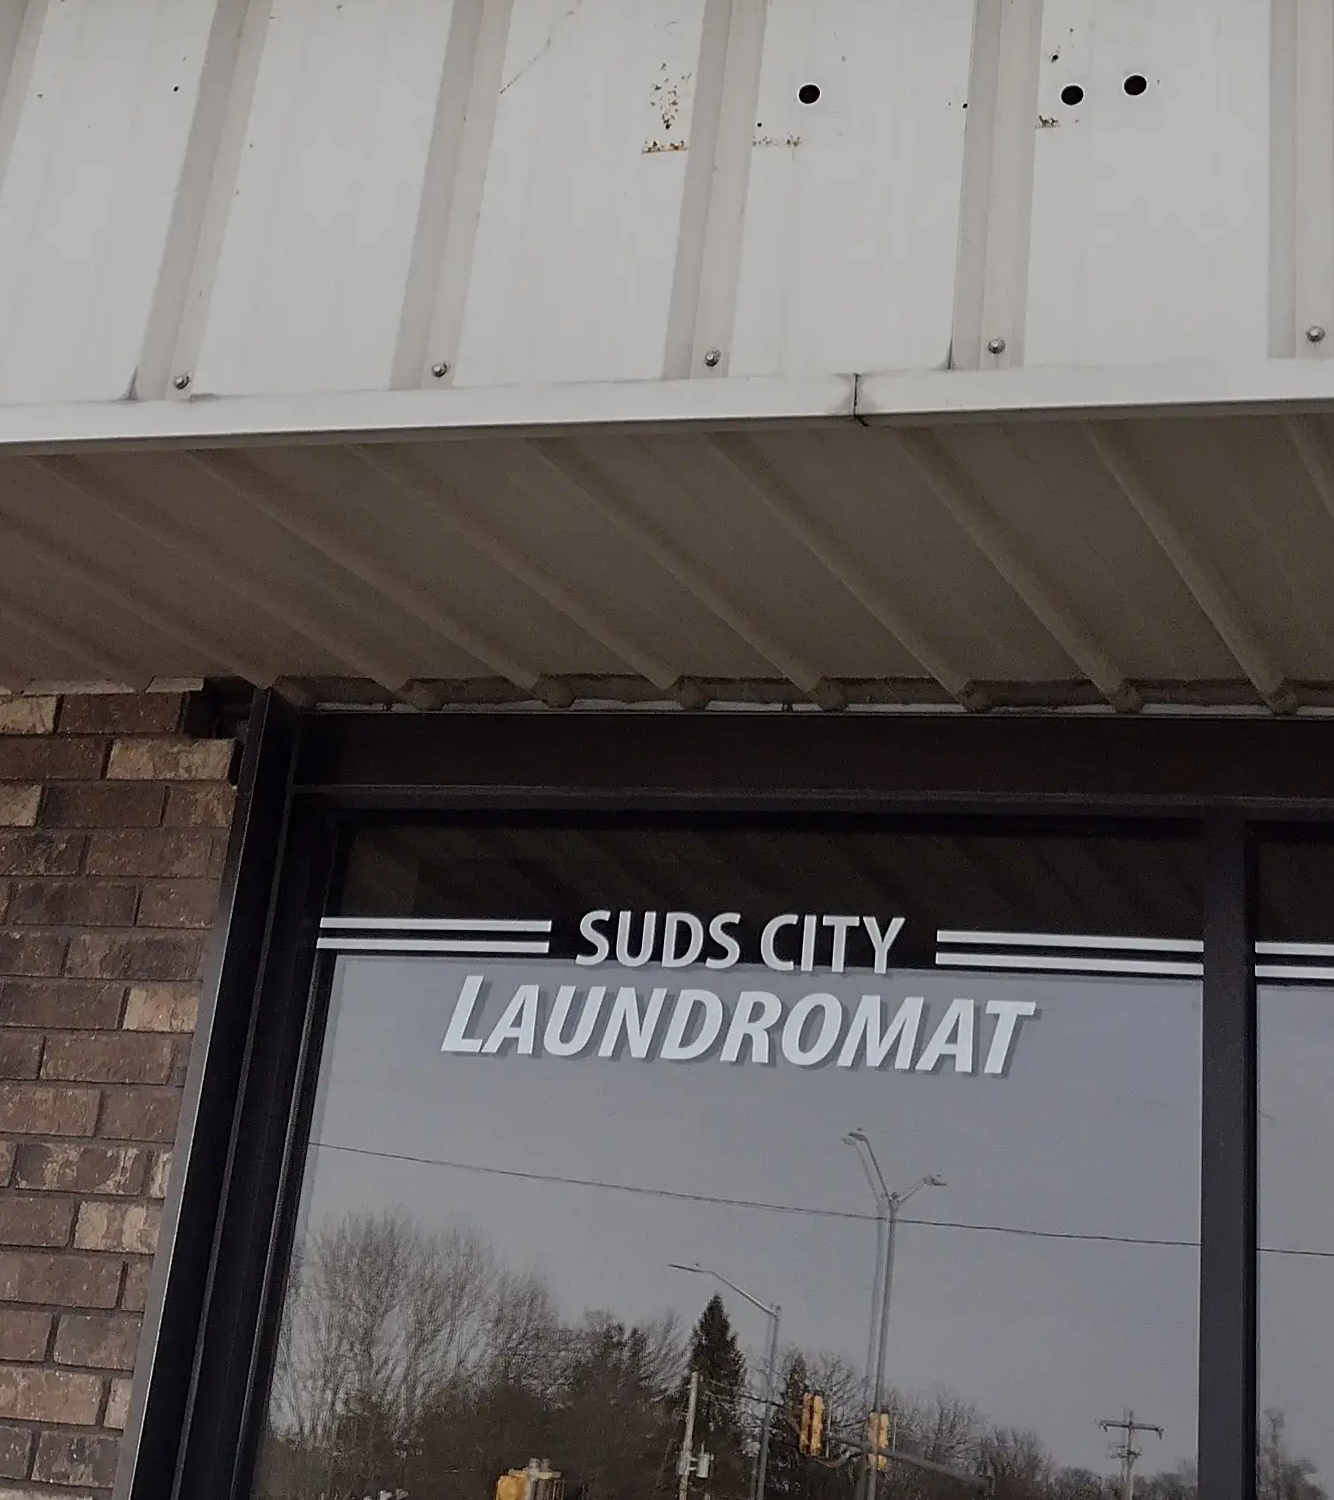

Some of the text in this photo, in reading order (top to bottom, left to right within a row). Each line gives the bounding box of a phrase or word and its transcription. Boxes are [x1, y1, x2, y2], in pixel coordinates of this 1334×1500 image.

[574, 910, 906, 975] SUDS CITY
[439, 975, 1038, 1075] LAUNDROMAT
